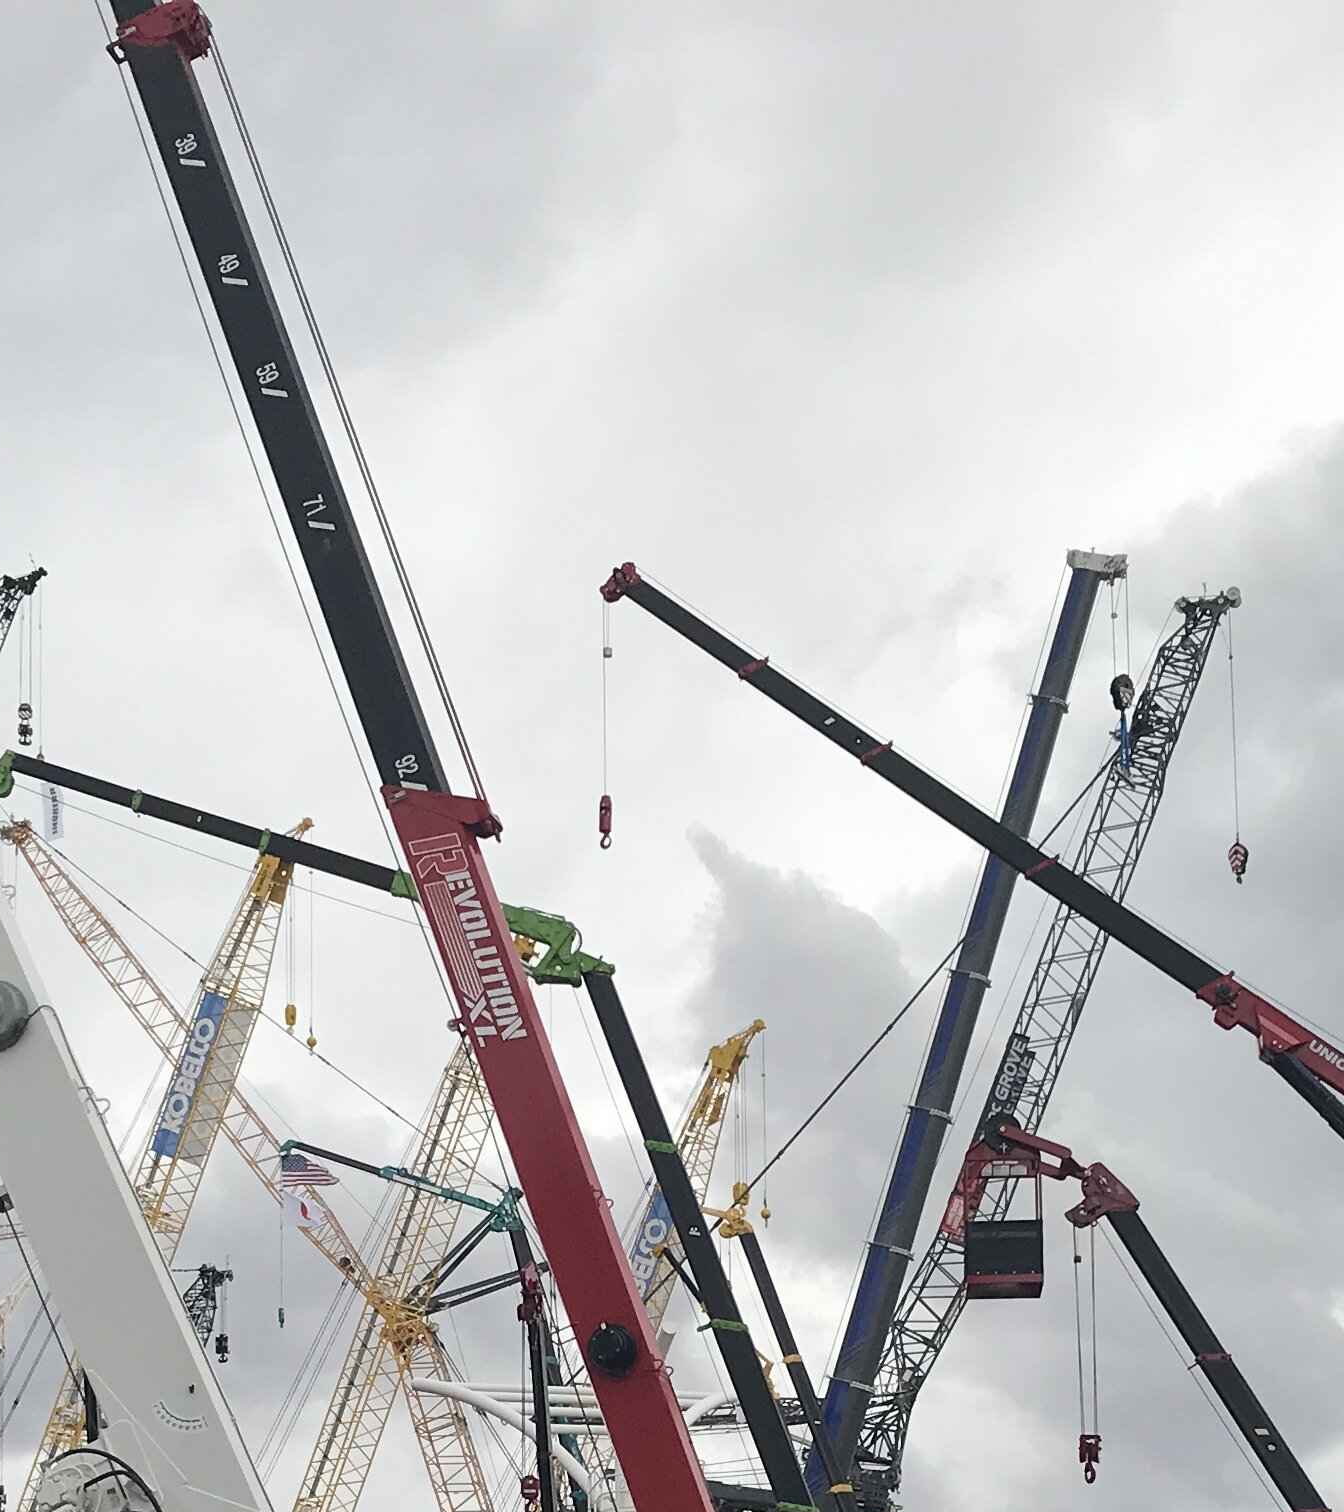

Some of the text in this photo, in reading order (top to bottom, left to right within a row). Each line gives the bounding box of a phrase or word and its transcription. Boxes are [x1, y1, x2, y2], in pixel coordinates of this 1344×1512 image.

[175, 132, 197, 156] 39
[217, 251, 240, 276] 49
[256, 361, 279, 389] 59
[303, 493, 327, 521] 71
[395, 753, 420, 782] 92
[408, 832, 528, 1042] REVOLUTION
[463, 995, 498, 1048] XL
[161, 1017, 215, 1134] KOBELCO
[995, 1037, 1027, 1101] GROVE
